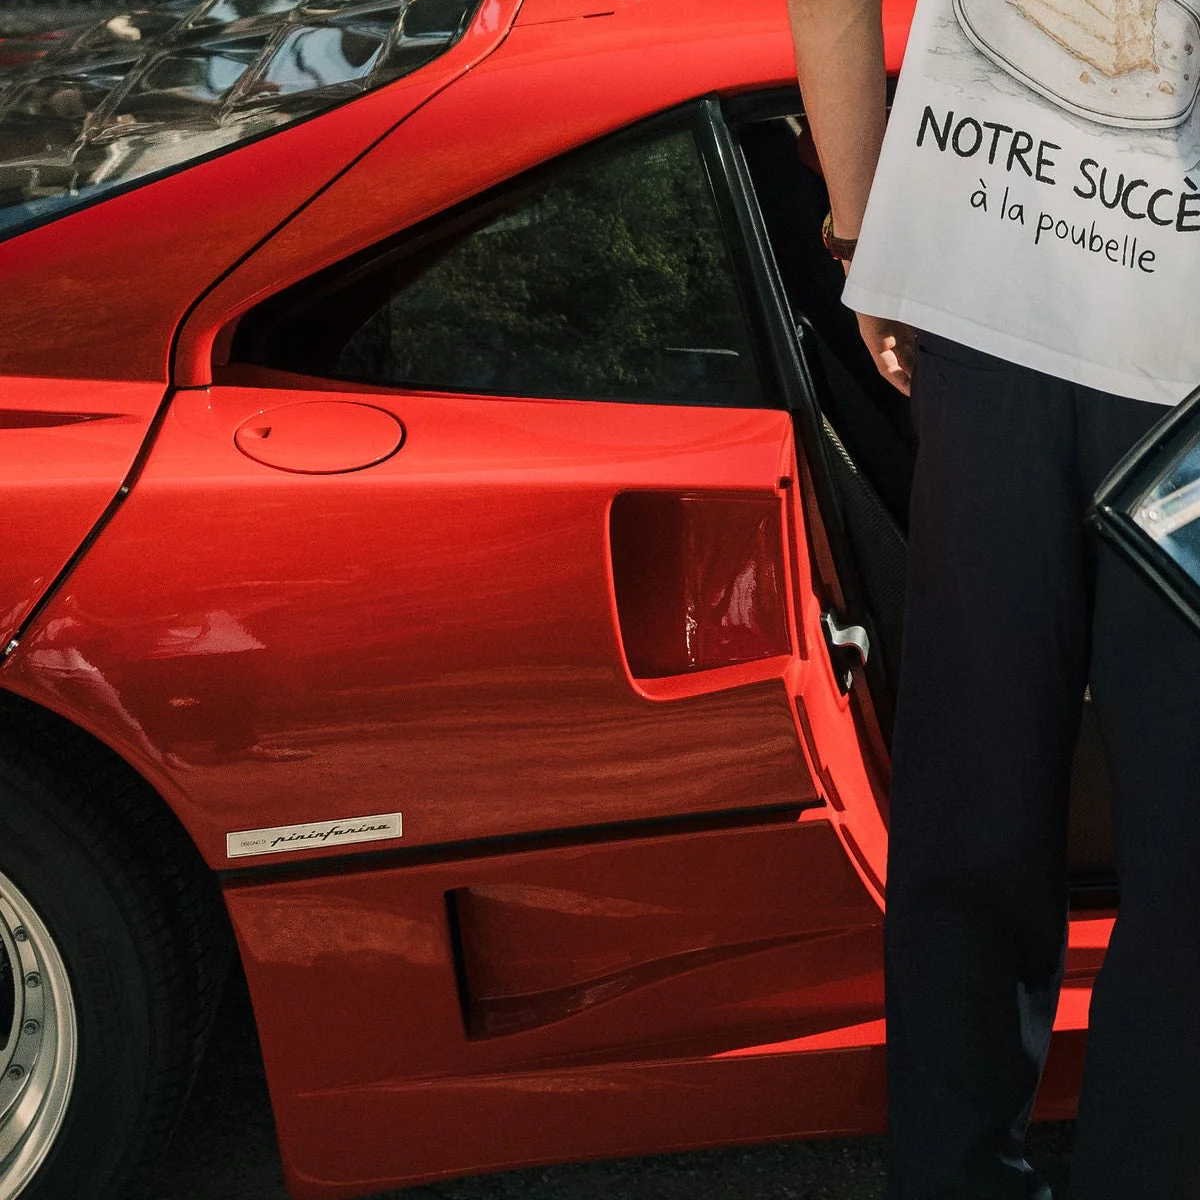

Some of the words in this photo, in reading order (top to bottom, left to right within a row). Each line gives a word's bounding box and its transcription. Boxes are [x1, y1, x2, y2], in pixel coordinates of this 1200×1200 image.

[916, 105, 1062, 185] NOTRE
[970, 178, 988, 212] à
[1000, 186, 1025, 226] la
[1034, 211, 1156, 273] poubelle
[270, 824, 392, 847] pininfarina
